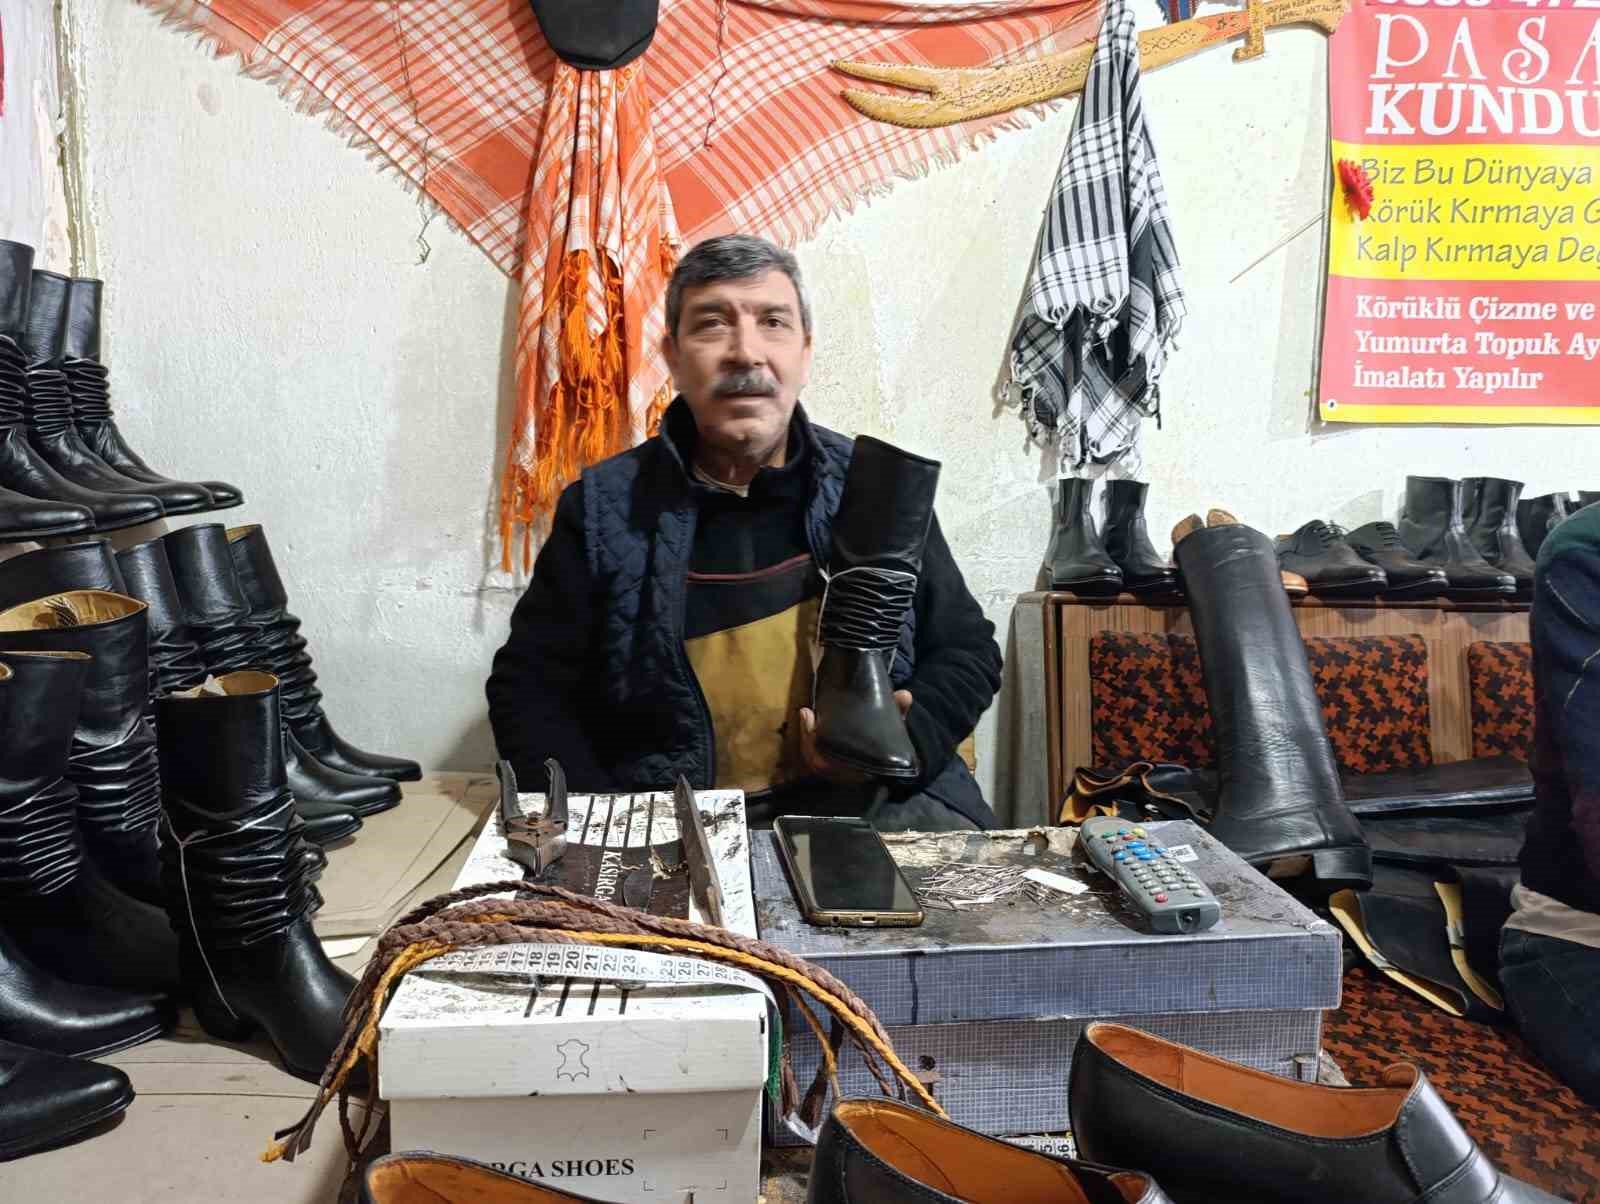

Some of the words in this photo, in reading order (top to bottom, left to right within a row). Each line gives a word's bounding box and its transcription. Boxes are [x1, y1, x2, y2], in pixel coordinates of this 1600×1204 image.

[1365, 82, 1600, 138] KUNDU
[1361, 158, 1405, 185] Biz
[1414, 158, 1454, 185] Bu
[1463, 158, 1592, 192] Dünyaya
[1352, 198, 1441, 224] örük
[1450, 198, 1575, 231] Kırmaya
[1357, 235, 1417, 272] Kalp
[1425, 236, 1549, 269] Kırmaya
[1355, 294, 1461, 320] Körüklü
[1469, 296, 1556, 324] Çizme
[1564, 302, 1595, 321] ve
[1354, 330, 1467, 355] Yumurta
[1474, 332, 1561, 359] Topuk
[1566, 331, 1600, 361] Ay
[1353, 360, 1446, 389] İmalatı
[1453, 366, 1543, 394] Yapılır
[511, 951, 525, 966] 17
[528, 951, 543, 967] 18
[546, 951, 561, 968] 19
[565, 950, 581, 969] 20
[584, 953, 599, 971] 21
[603, 953, 618, 972] 22
[622, 954, 637, 974] 23
[678, 961, 692, 976] 26
[697, 963, 711, 977] 27
[715, 965, 728, 979] 28
[551, 1158, 634, 1177] SHOES
